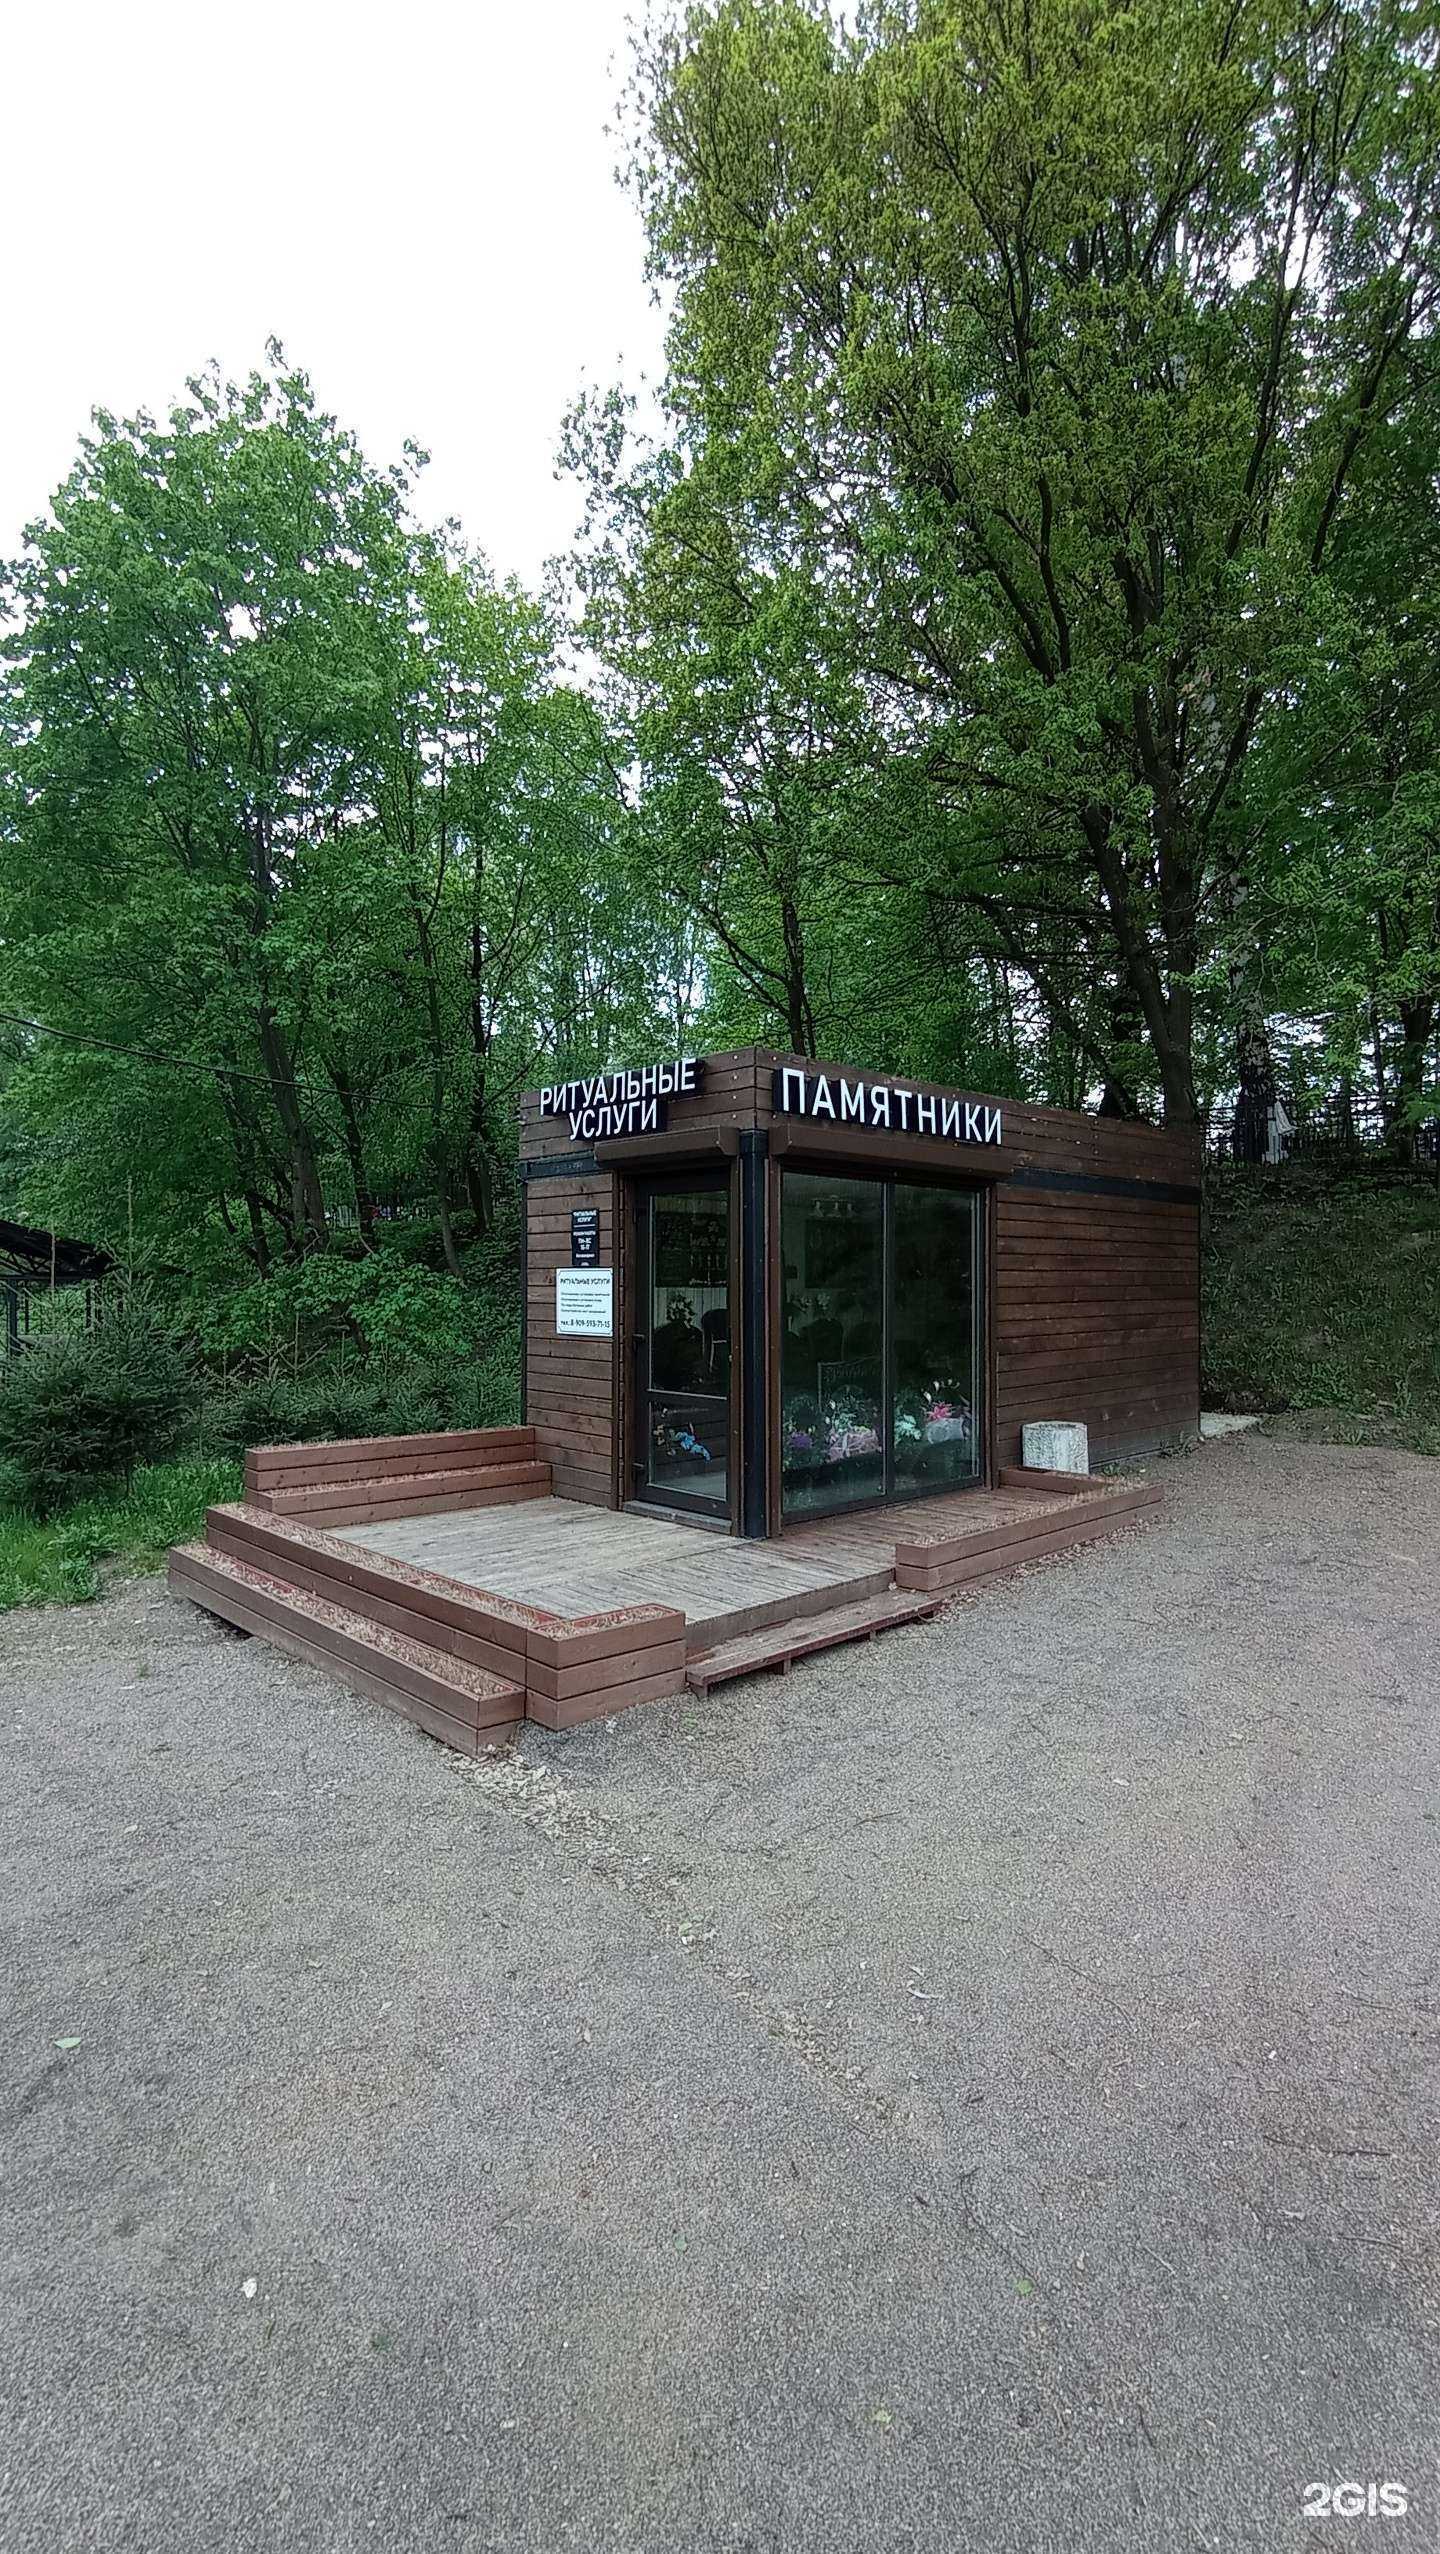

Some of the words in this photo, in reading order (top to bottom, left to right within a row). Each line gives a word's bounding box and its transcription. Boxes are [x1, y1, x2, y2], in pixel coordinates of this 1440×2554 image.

[540, 1057, 697, 1115] РИТУАЛЬНЫЕ
[782, 1067, 1002, 1145] ПАМЯТНИКИ
[568, 1098, 657, 1141] УСЛУГИ
